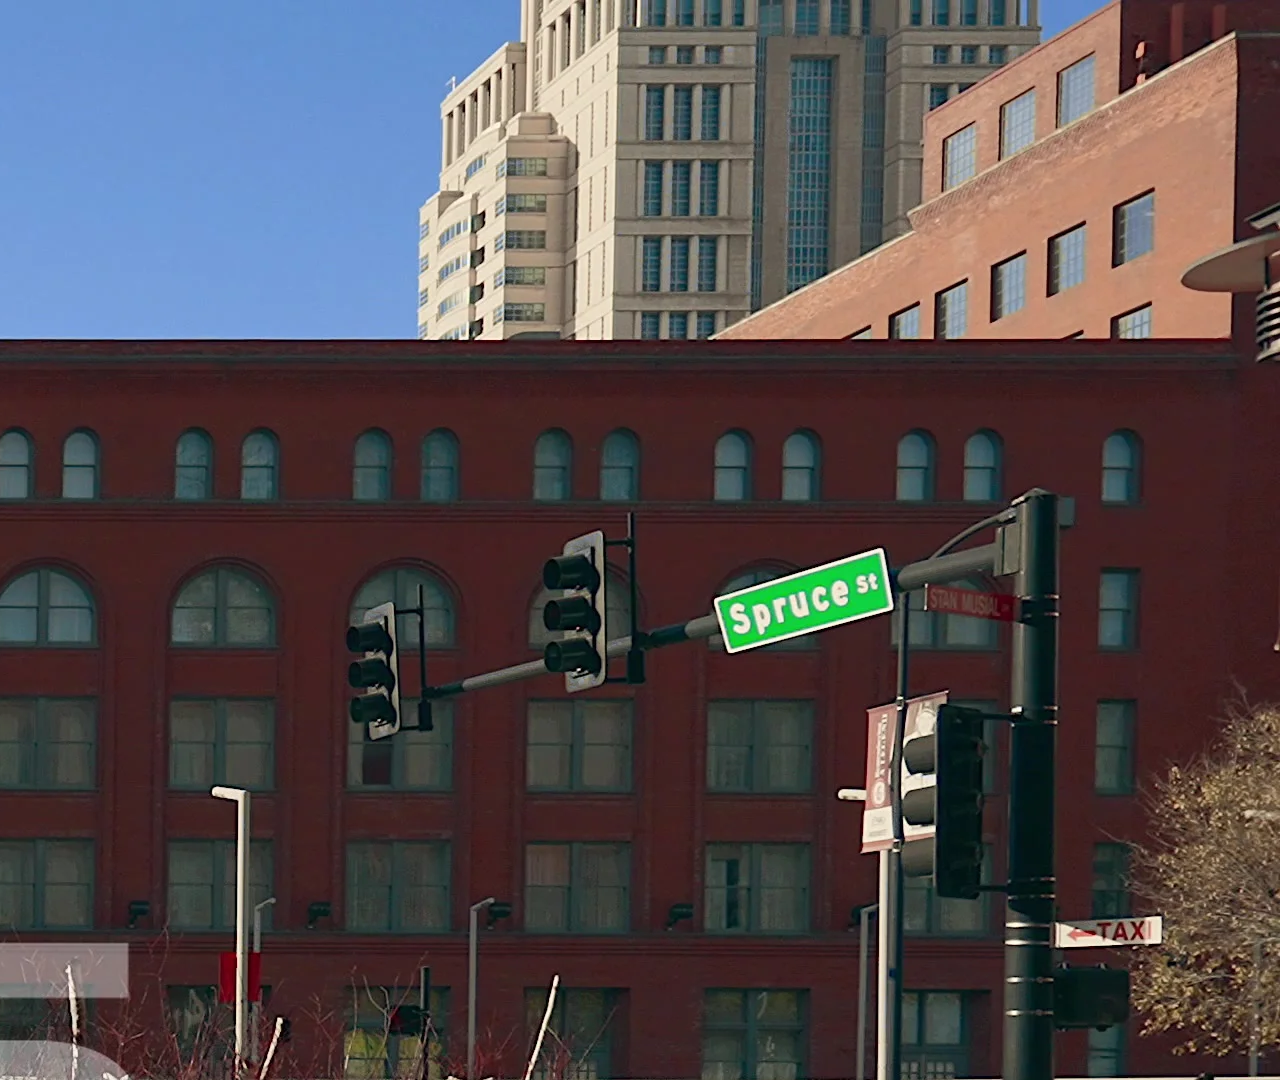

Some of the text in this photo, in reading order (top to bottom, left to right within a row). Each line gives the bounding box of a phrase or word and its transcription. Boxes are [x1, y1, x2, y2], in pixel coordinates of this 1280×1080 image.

[729, 573, 878, 635] Spruce St
[930, 588, 957, 609] STAN
[962, 593, 1001, 617] MUSIAL
[1096, 920, 1152, 942] TAXI
